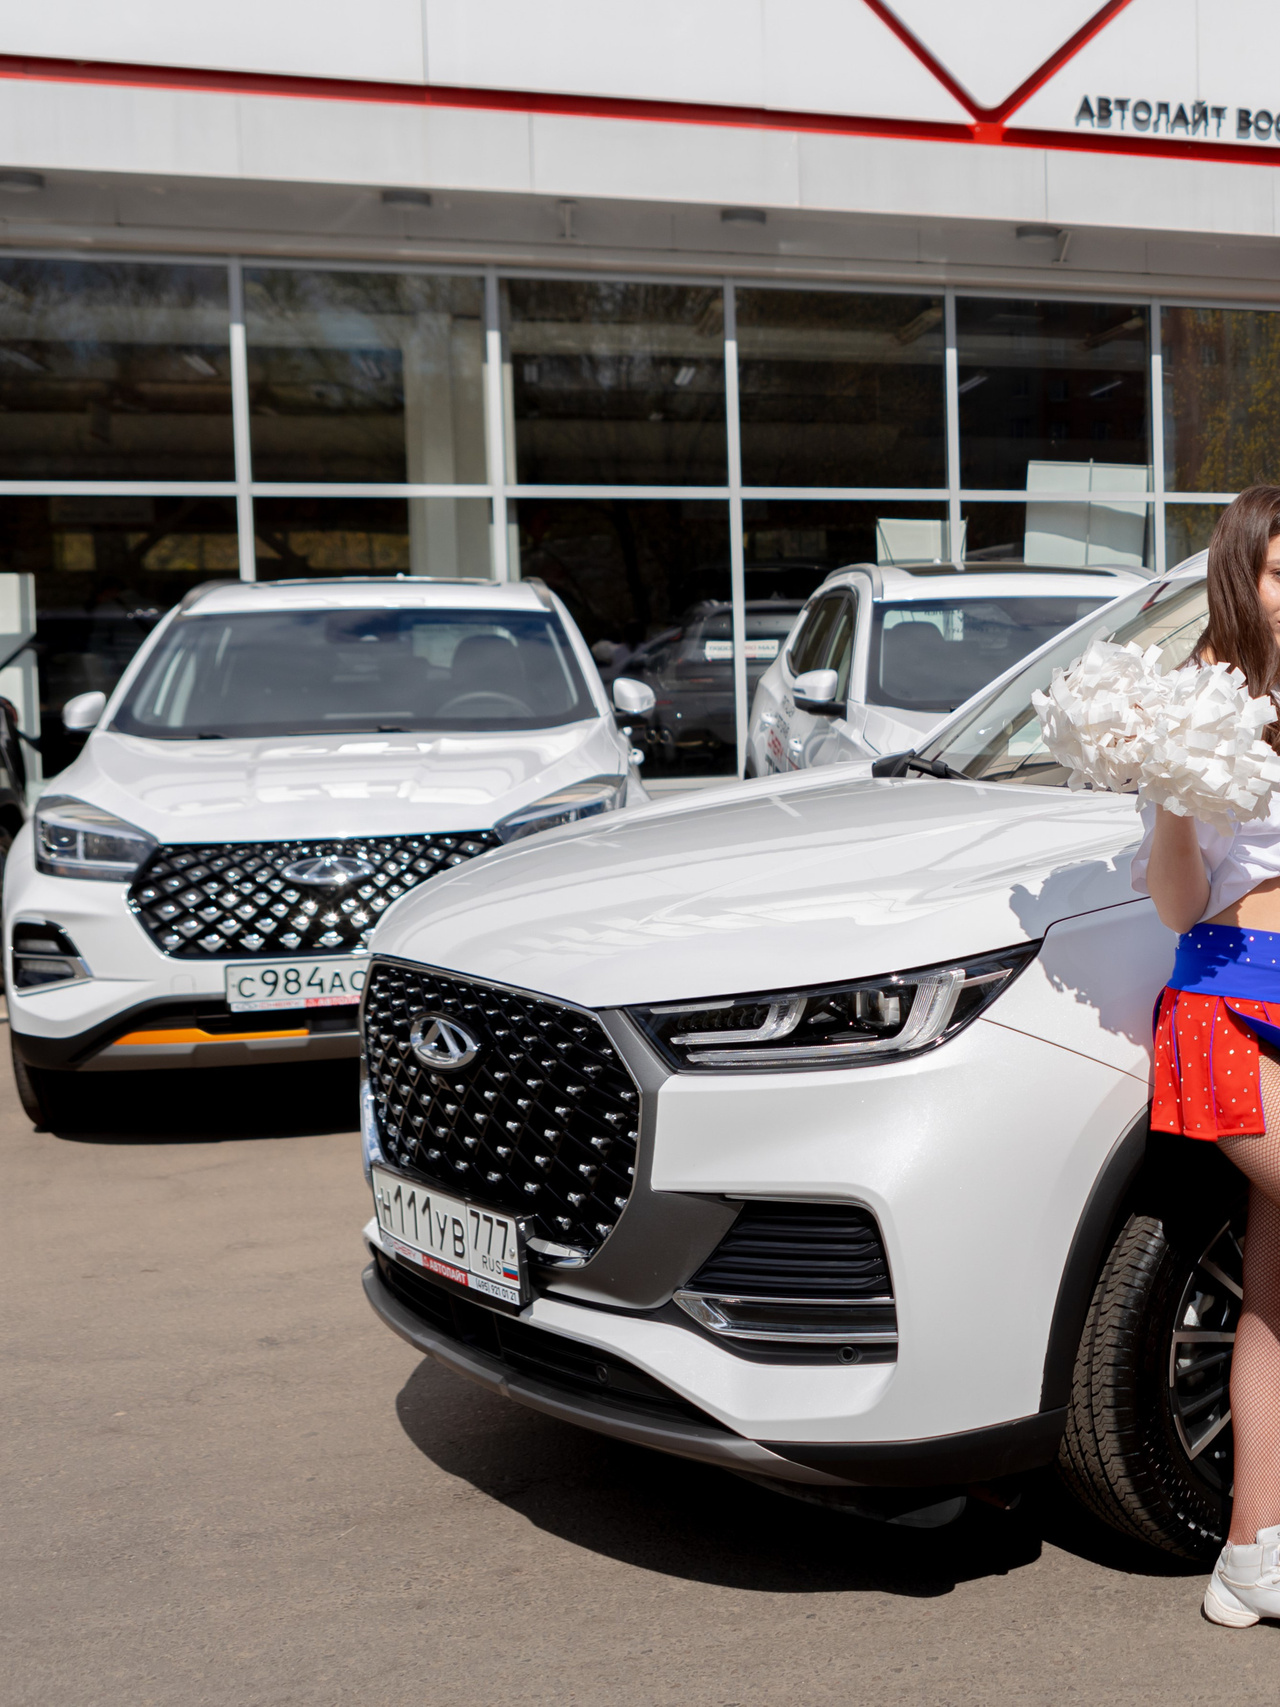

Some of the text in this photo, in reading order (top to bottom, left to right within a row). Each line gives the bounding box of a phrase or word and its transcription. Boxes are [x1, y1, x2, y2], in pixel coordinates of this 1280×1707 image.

[1075, 94, 1227, 138] АВТОЛАЙТ
[380, 1184, 509, 1260] Н111УВ 777
[429, 1258, 467, 1285] АВТОЛАЙТ
[482, 1254, 502, 1275] RUS
[475, 1277, 490, 1293] (495)
[491, 1284, 501, 1296] 921
